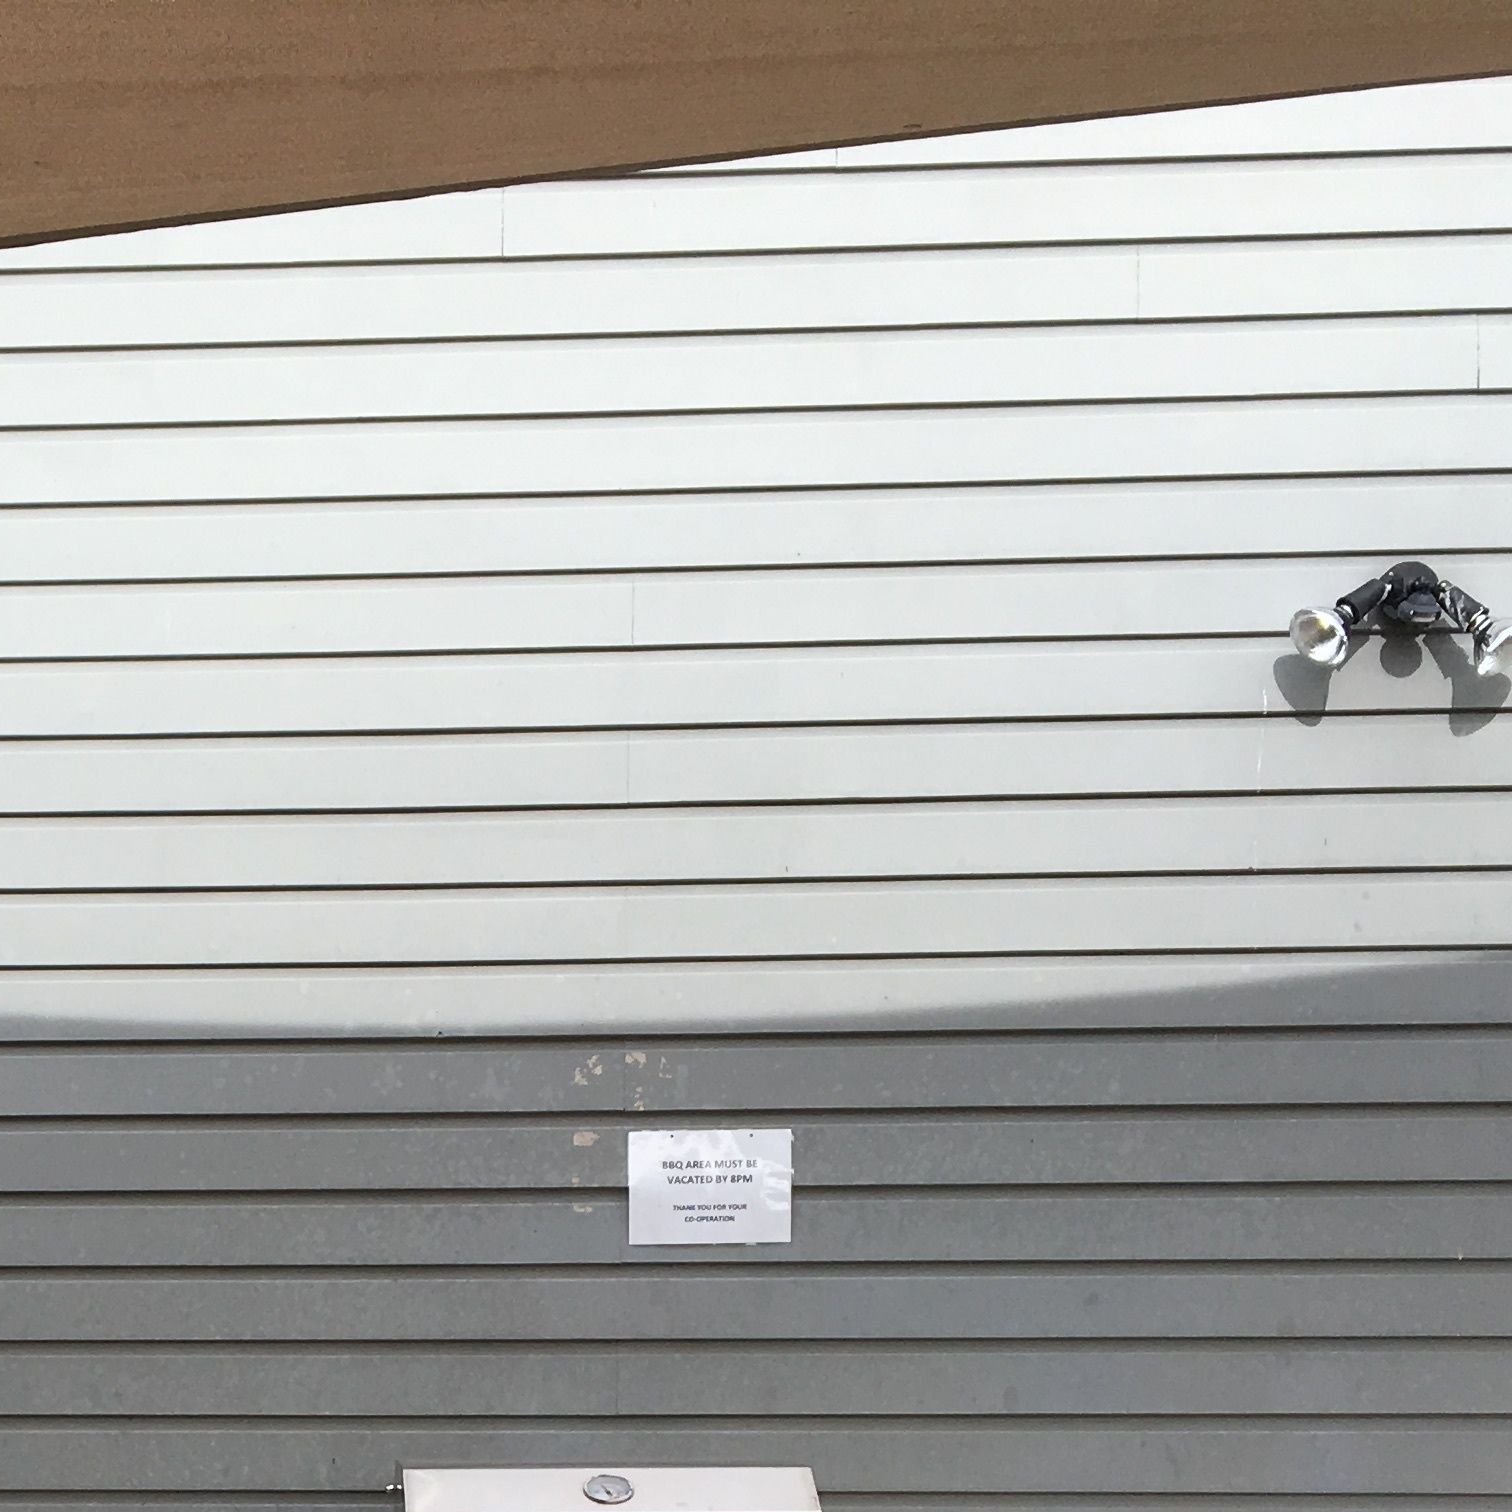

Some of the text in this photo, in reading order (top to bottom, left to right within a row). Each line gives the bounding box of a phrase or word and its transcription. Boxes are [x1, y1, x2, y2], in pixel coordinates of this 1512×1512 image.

[662, 1159, 758, 1170] BBQ AREA MUST BE
[667, 1174, 753, 1184] VACATED BY 8PM
[728, 1203, 747, 1211] YOUR
[684, 1215, 736, 1223] CO-OPERATION
